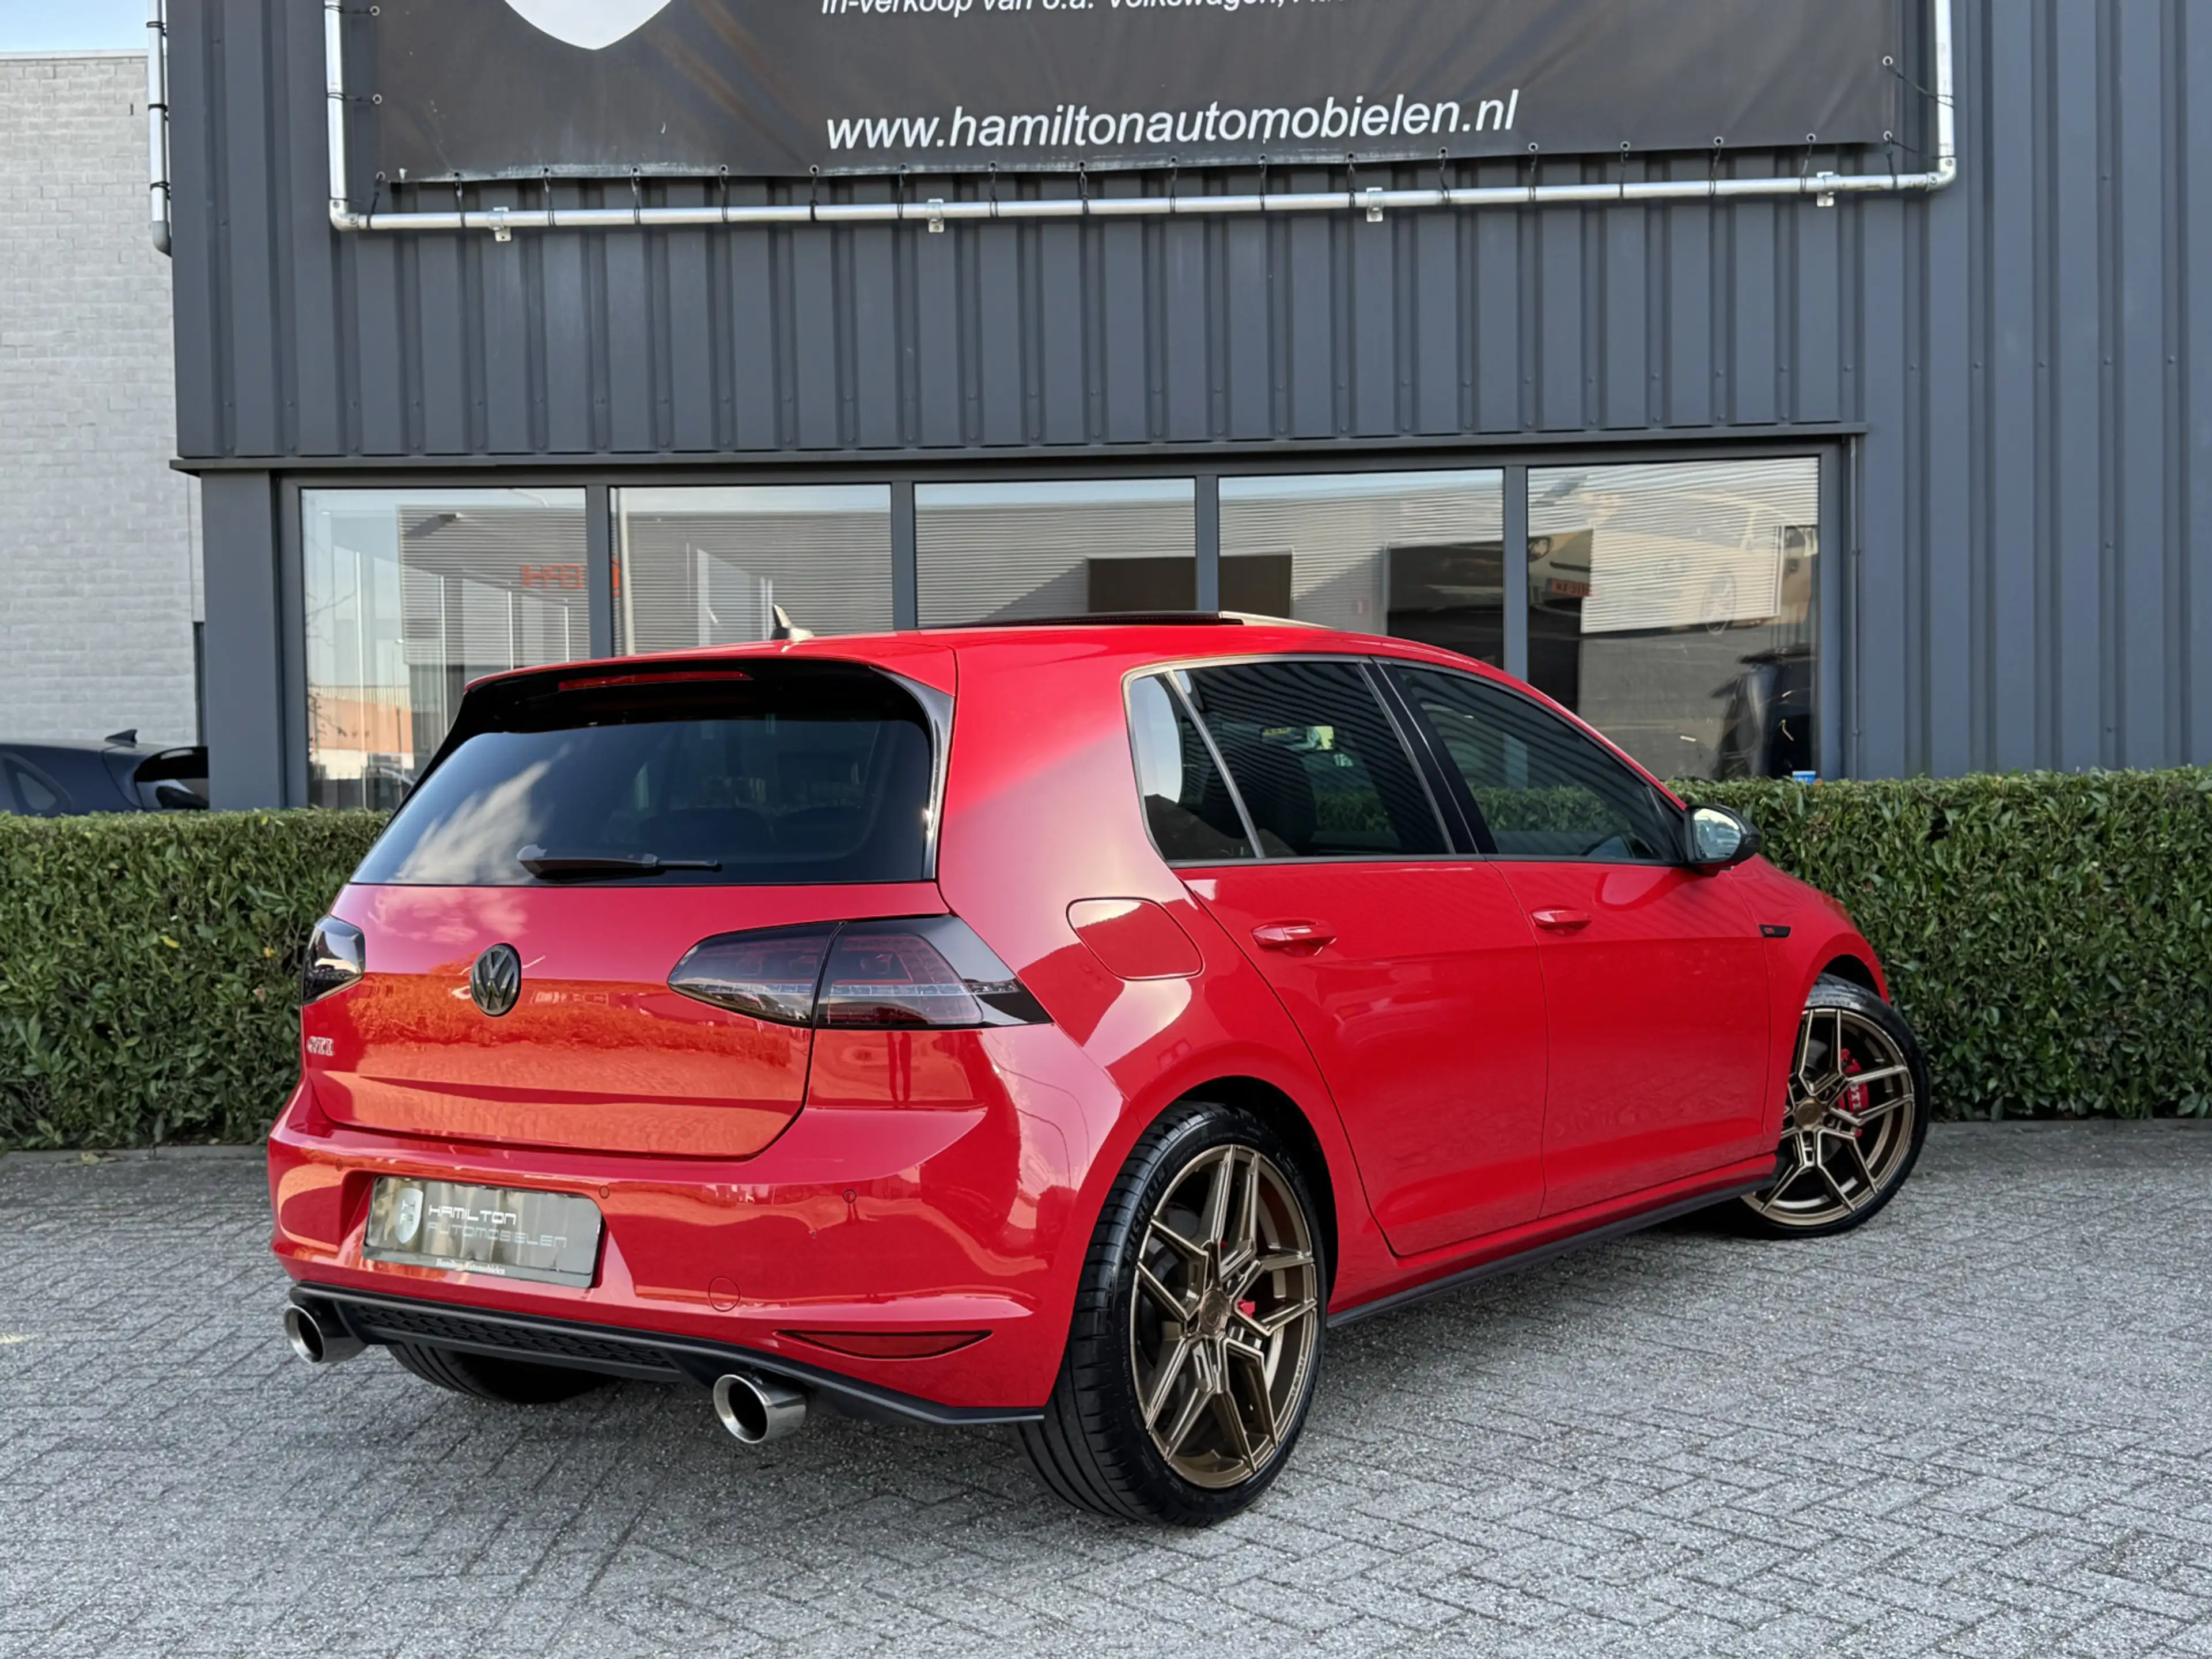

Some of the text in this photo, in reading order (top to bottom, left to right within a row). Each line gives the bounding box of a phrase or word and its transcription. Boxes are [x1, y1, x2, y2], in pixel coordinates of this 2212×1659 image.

[827, 89, 1519, 149] www.hamiltonautomobielen.nl
[427, 1221, 567, 1249] AUTOMOBIELEN
[428, 1204, 517, 1226] HAMILTON
[1123, 1165, 1169, 1263] MICHELIN
